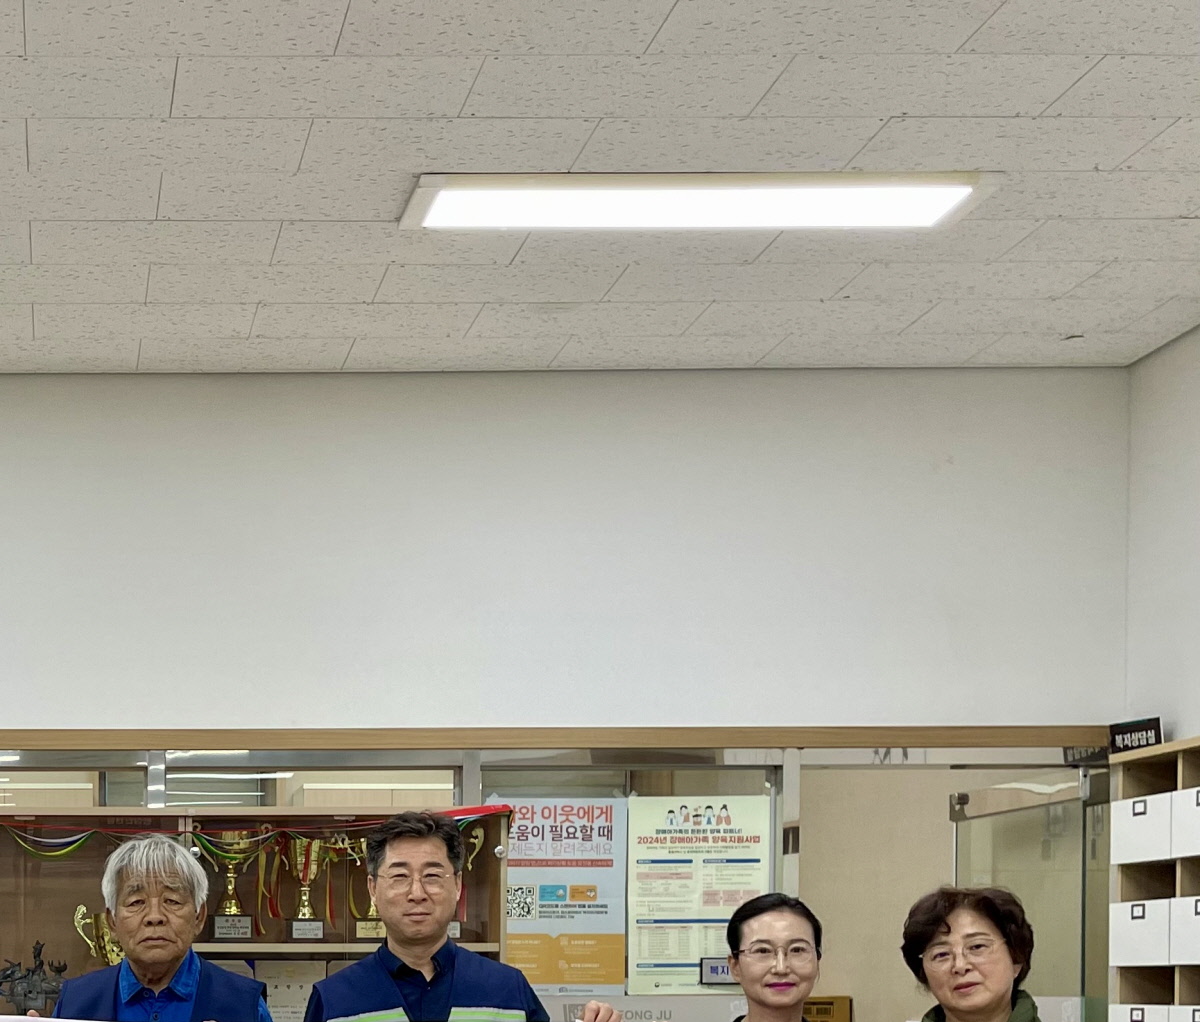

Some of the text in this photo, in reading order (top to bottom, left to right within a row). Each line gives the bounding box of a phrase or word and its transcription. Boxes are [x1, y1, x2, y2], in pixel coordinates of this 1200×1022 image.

[1115, 730, 1155, 748] 복지상담실
[541, 805, 613, 824] 이웃에게
[549, 825, 594, 841] 필요할
[598, 825, 612, 841] 때
[637, 836, 667, 844] 2024년
[510, 843, 613, 856] 제든지 알려주세요
[656, 1010, 672, 1020] JU
